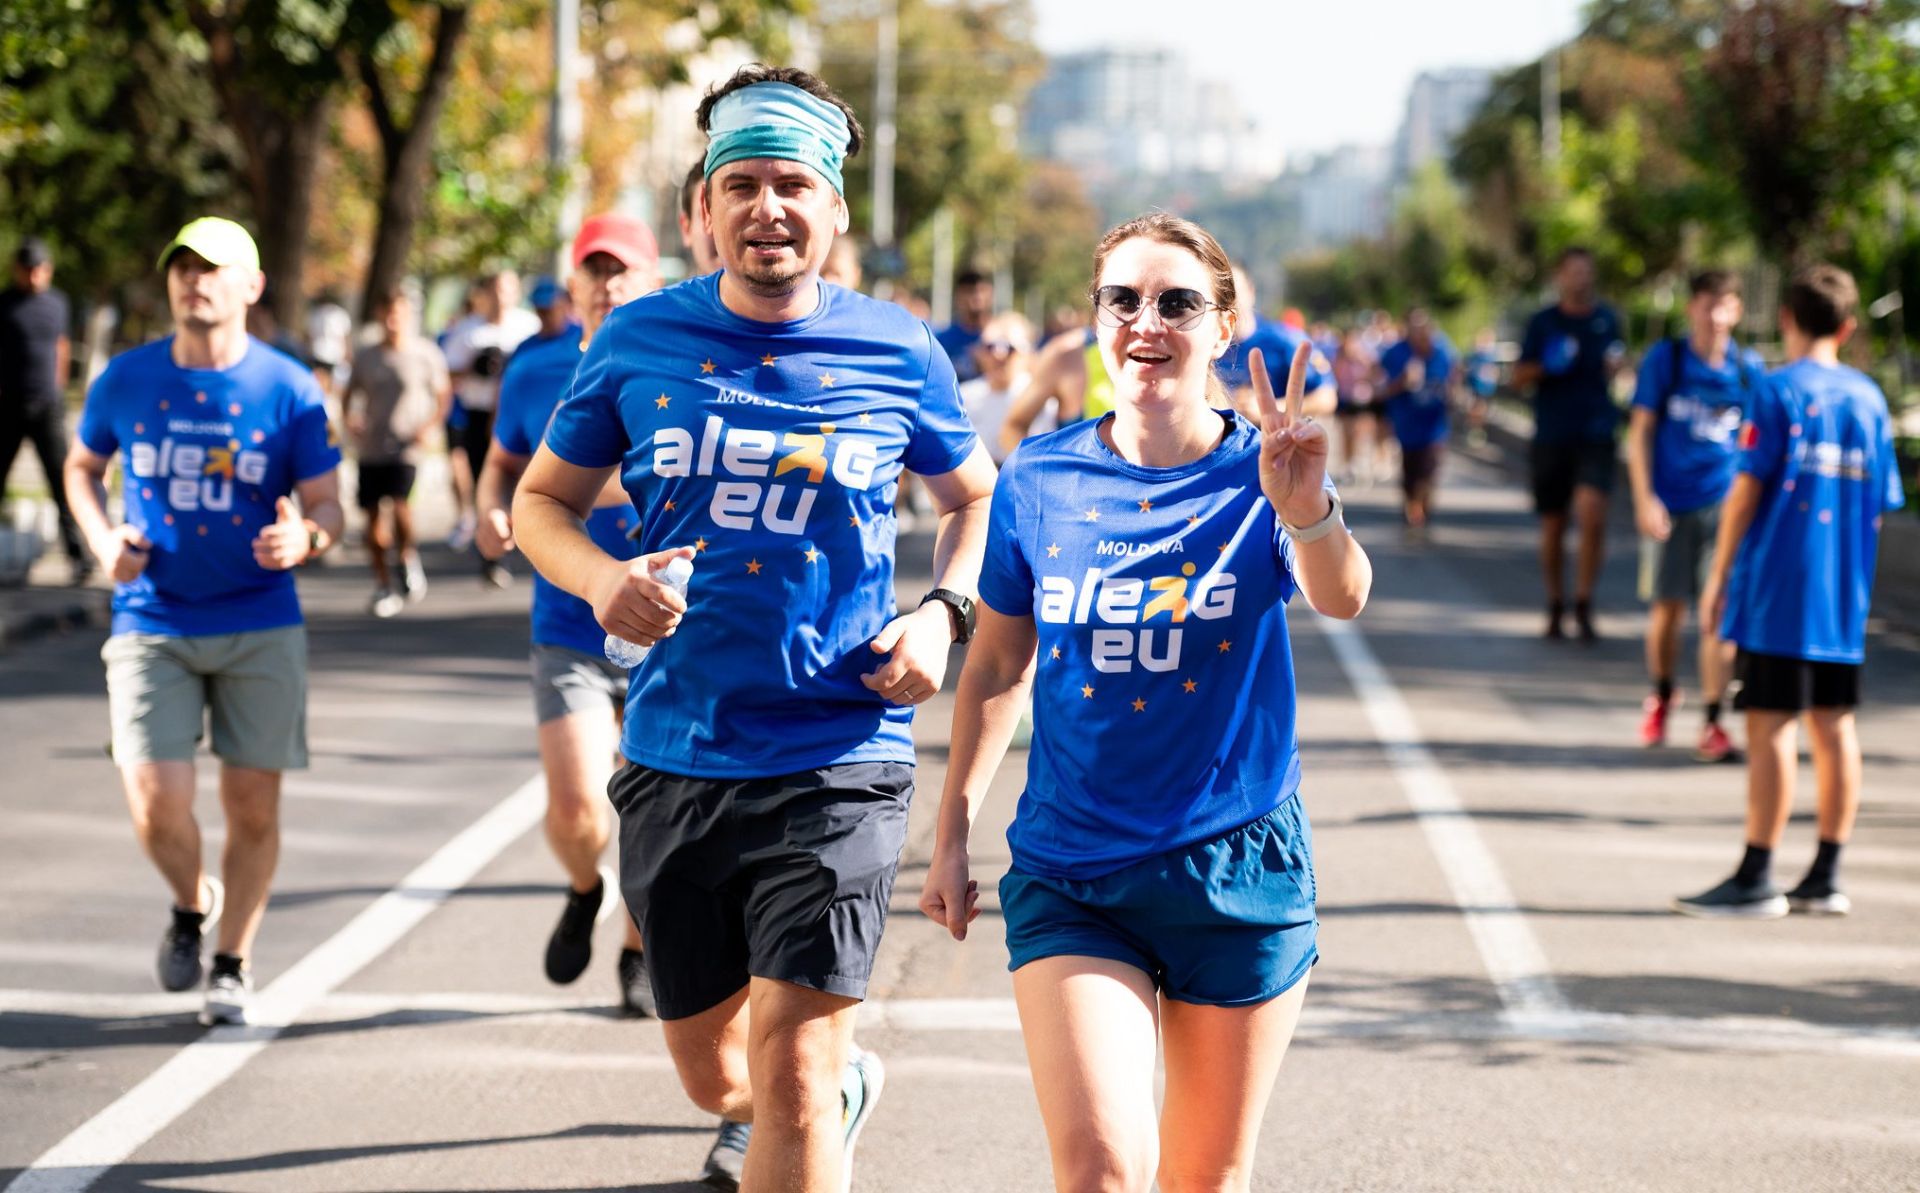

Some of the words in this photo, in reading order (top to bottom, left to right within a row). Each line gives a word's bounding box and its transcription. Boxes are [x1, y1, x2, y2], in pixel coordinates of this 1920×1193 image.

[169, 477, 234, 512] eu
[709, 482, 818, 535] eu
[1096, 540, 1184, 557] MOLDOVA
[1091, 628, 1184, 673] eu
